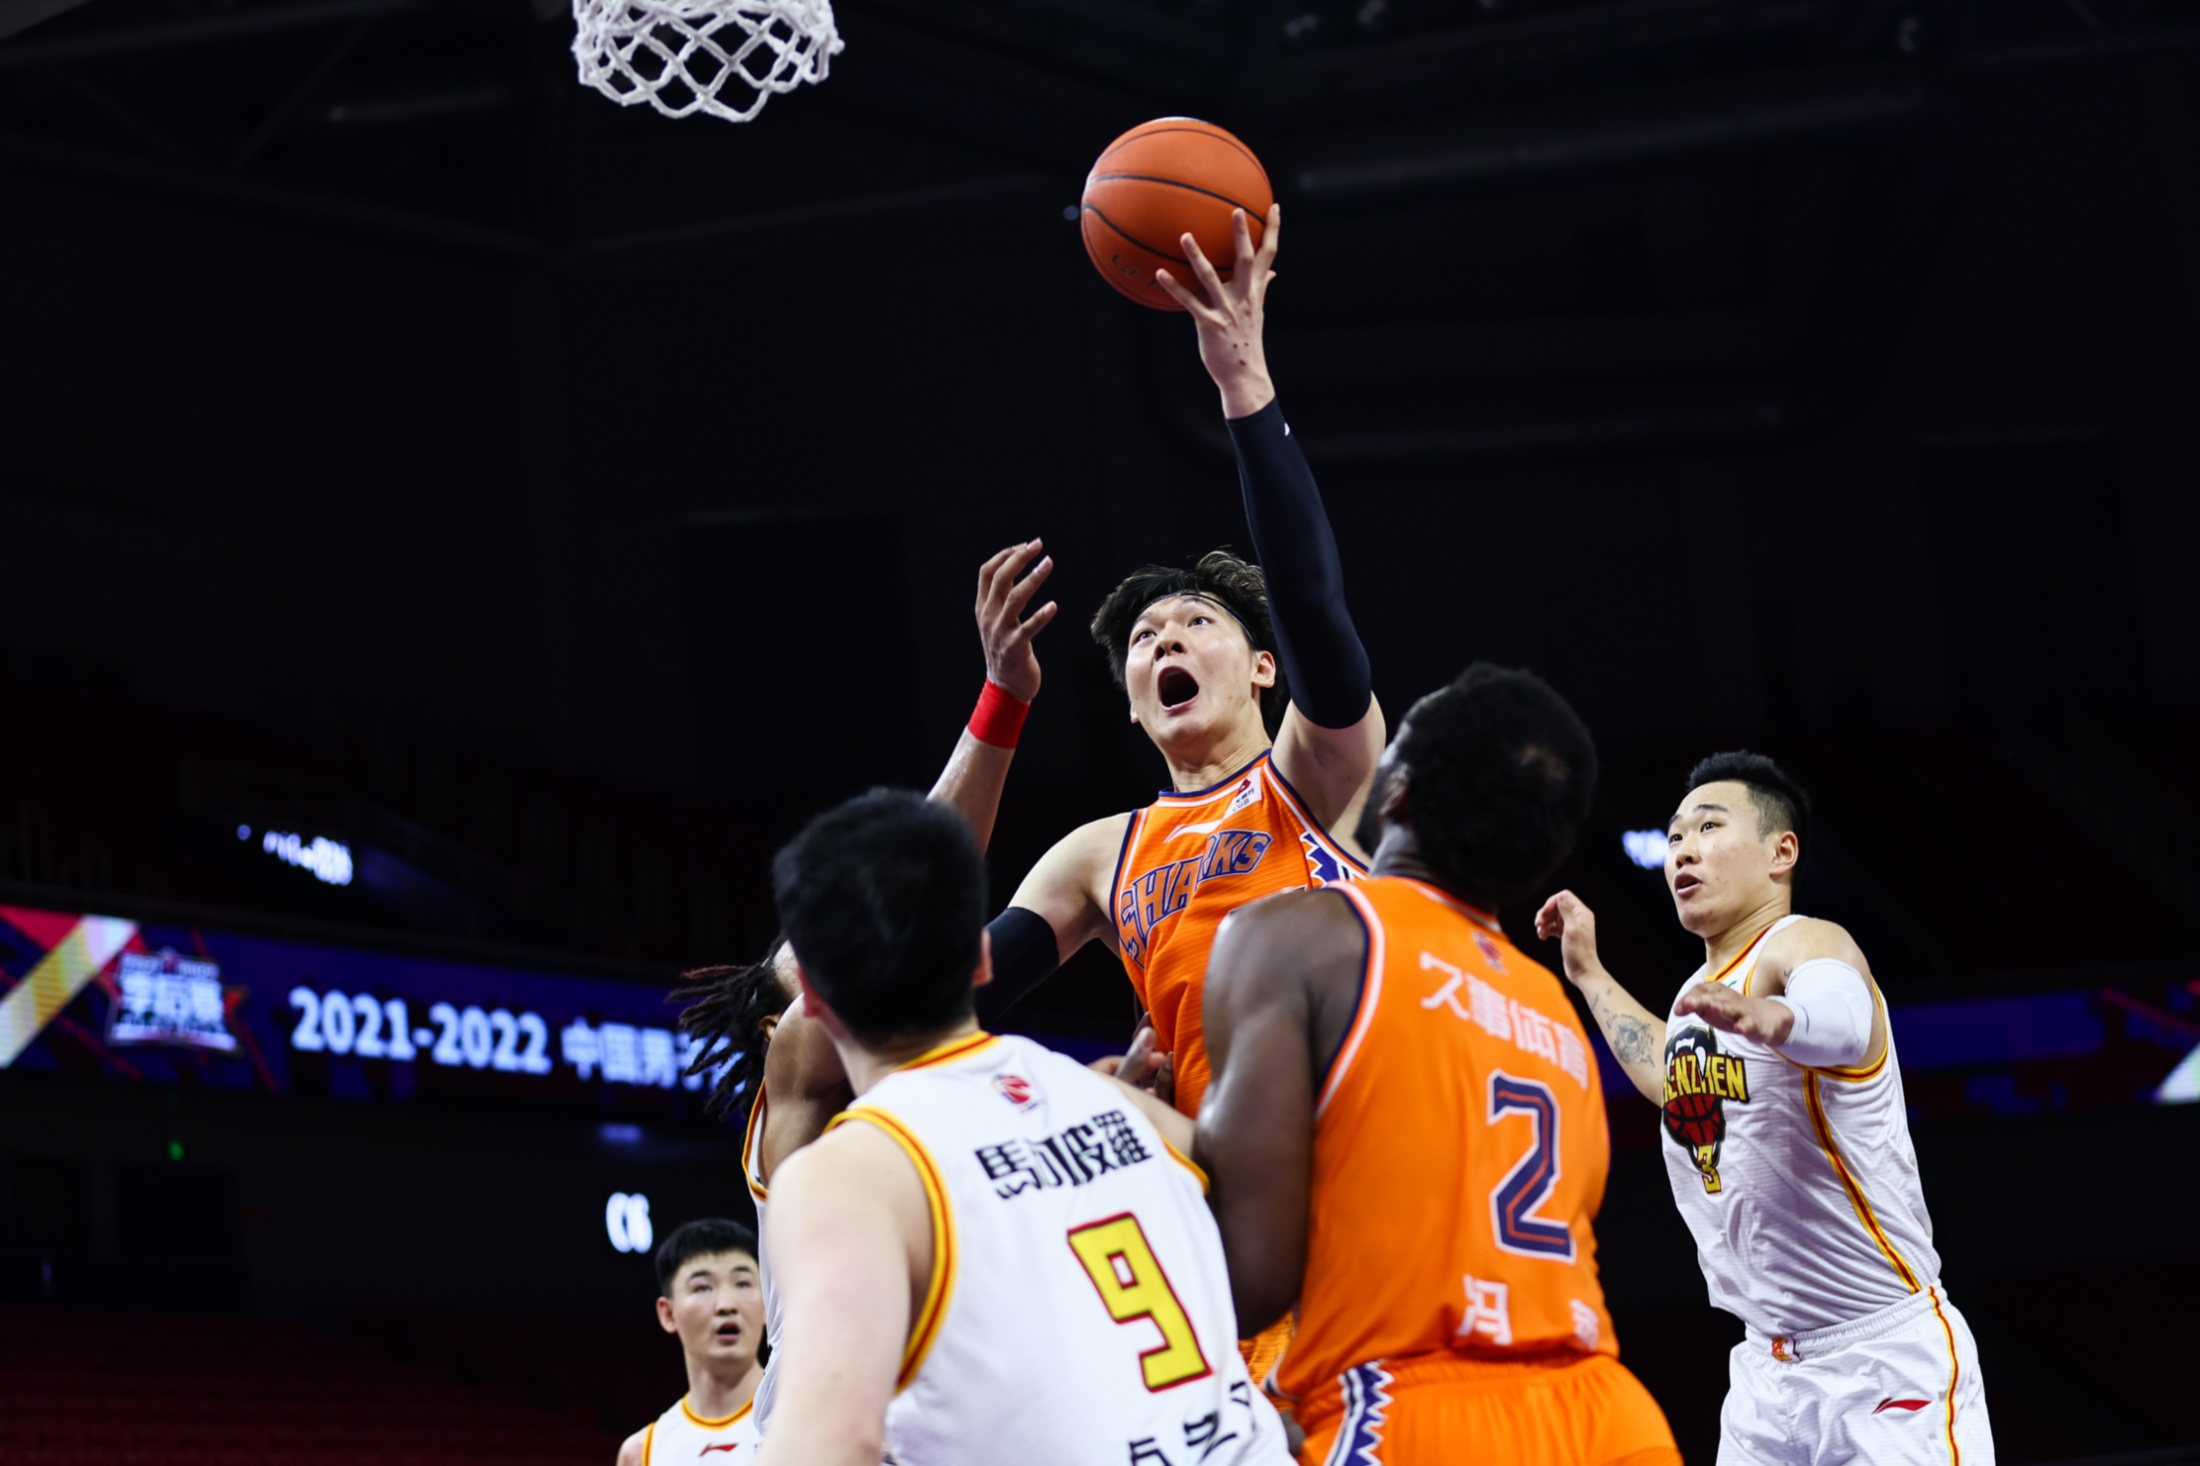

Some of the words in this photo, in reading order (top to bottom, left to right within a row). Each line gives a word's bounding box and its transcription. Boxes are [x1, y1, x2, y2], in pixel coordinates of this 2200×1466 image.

[288, 986, 553, 1076] 2021-2022
[1486, 1069, 1577, 1265] 2
[1696, 1143, 1722, 1195] 3
[1066, 1211, 1214, 1393] 9
